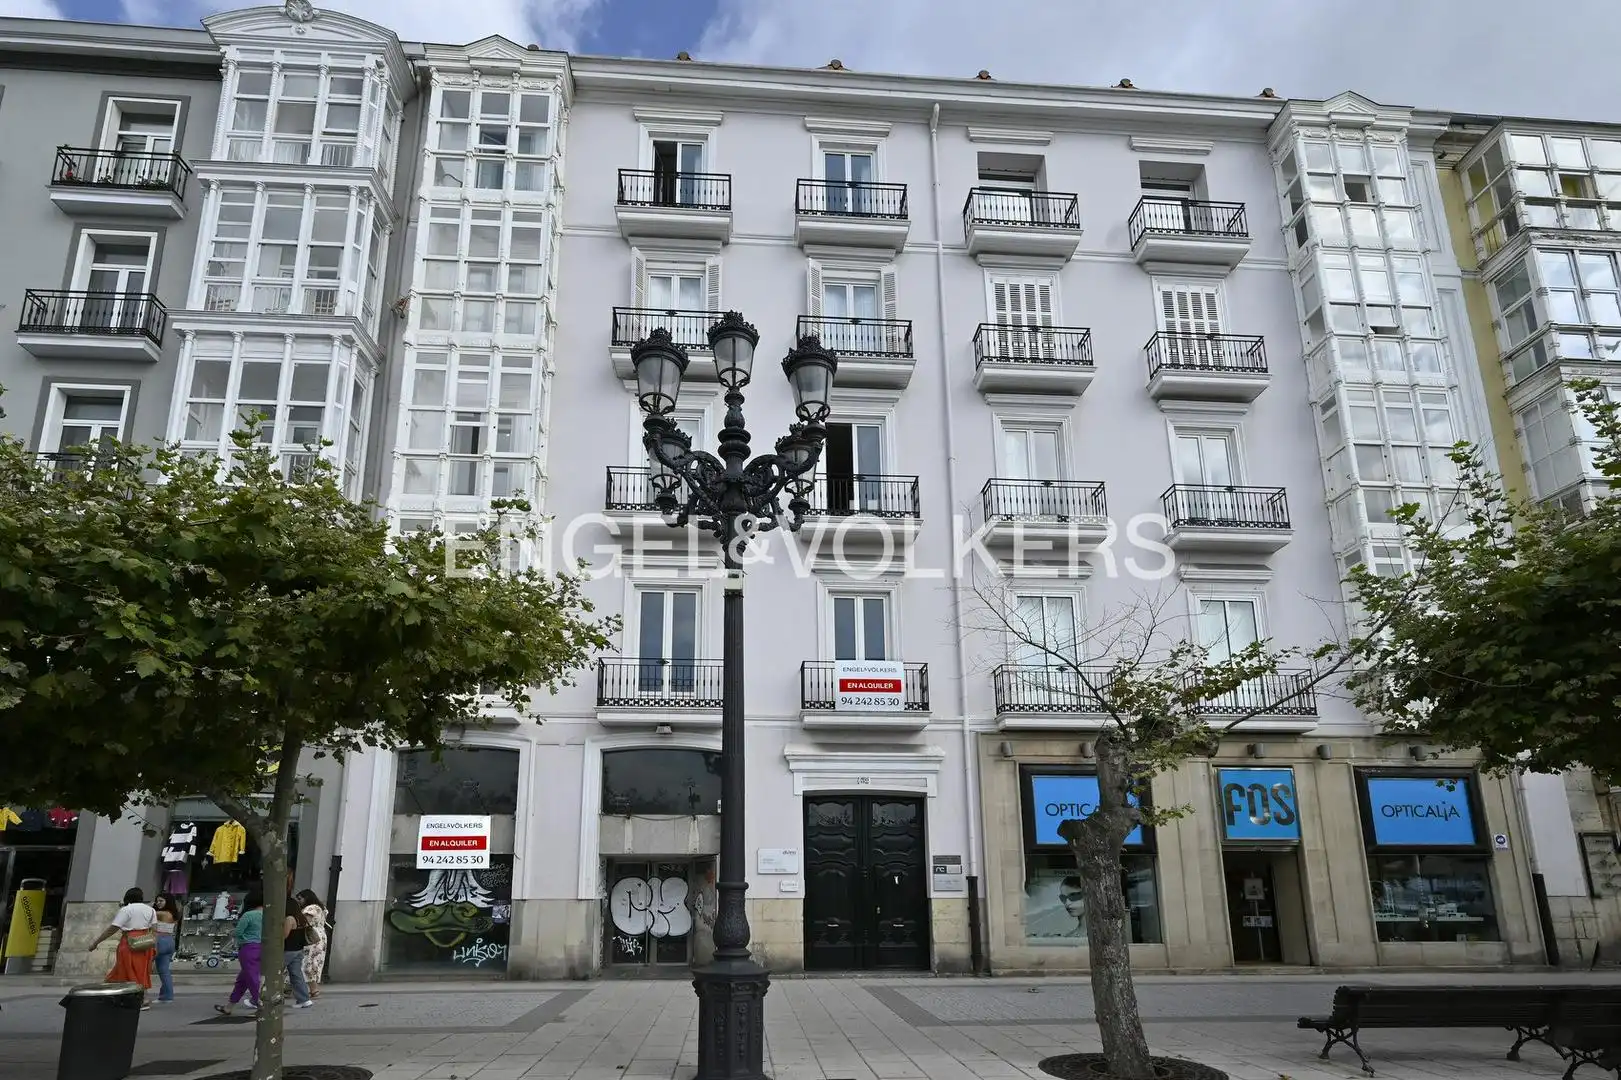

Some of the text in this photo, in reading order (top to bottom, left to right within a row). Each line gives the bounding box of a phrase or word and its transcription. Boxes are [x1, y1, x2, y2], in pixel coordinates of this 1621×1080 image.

[841, 697, 899, 706] 94 242 85 30
[1223, 783, 1296, 826] FOS
[429, 839, 478, 847] EN ALQUILER
[422, 855, 484, 864] 94 242 85 30
